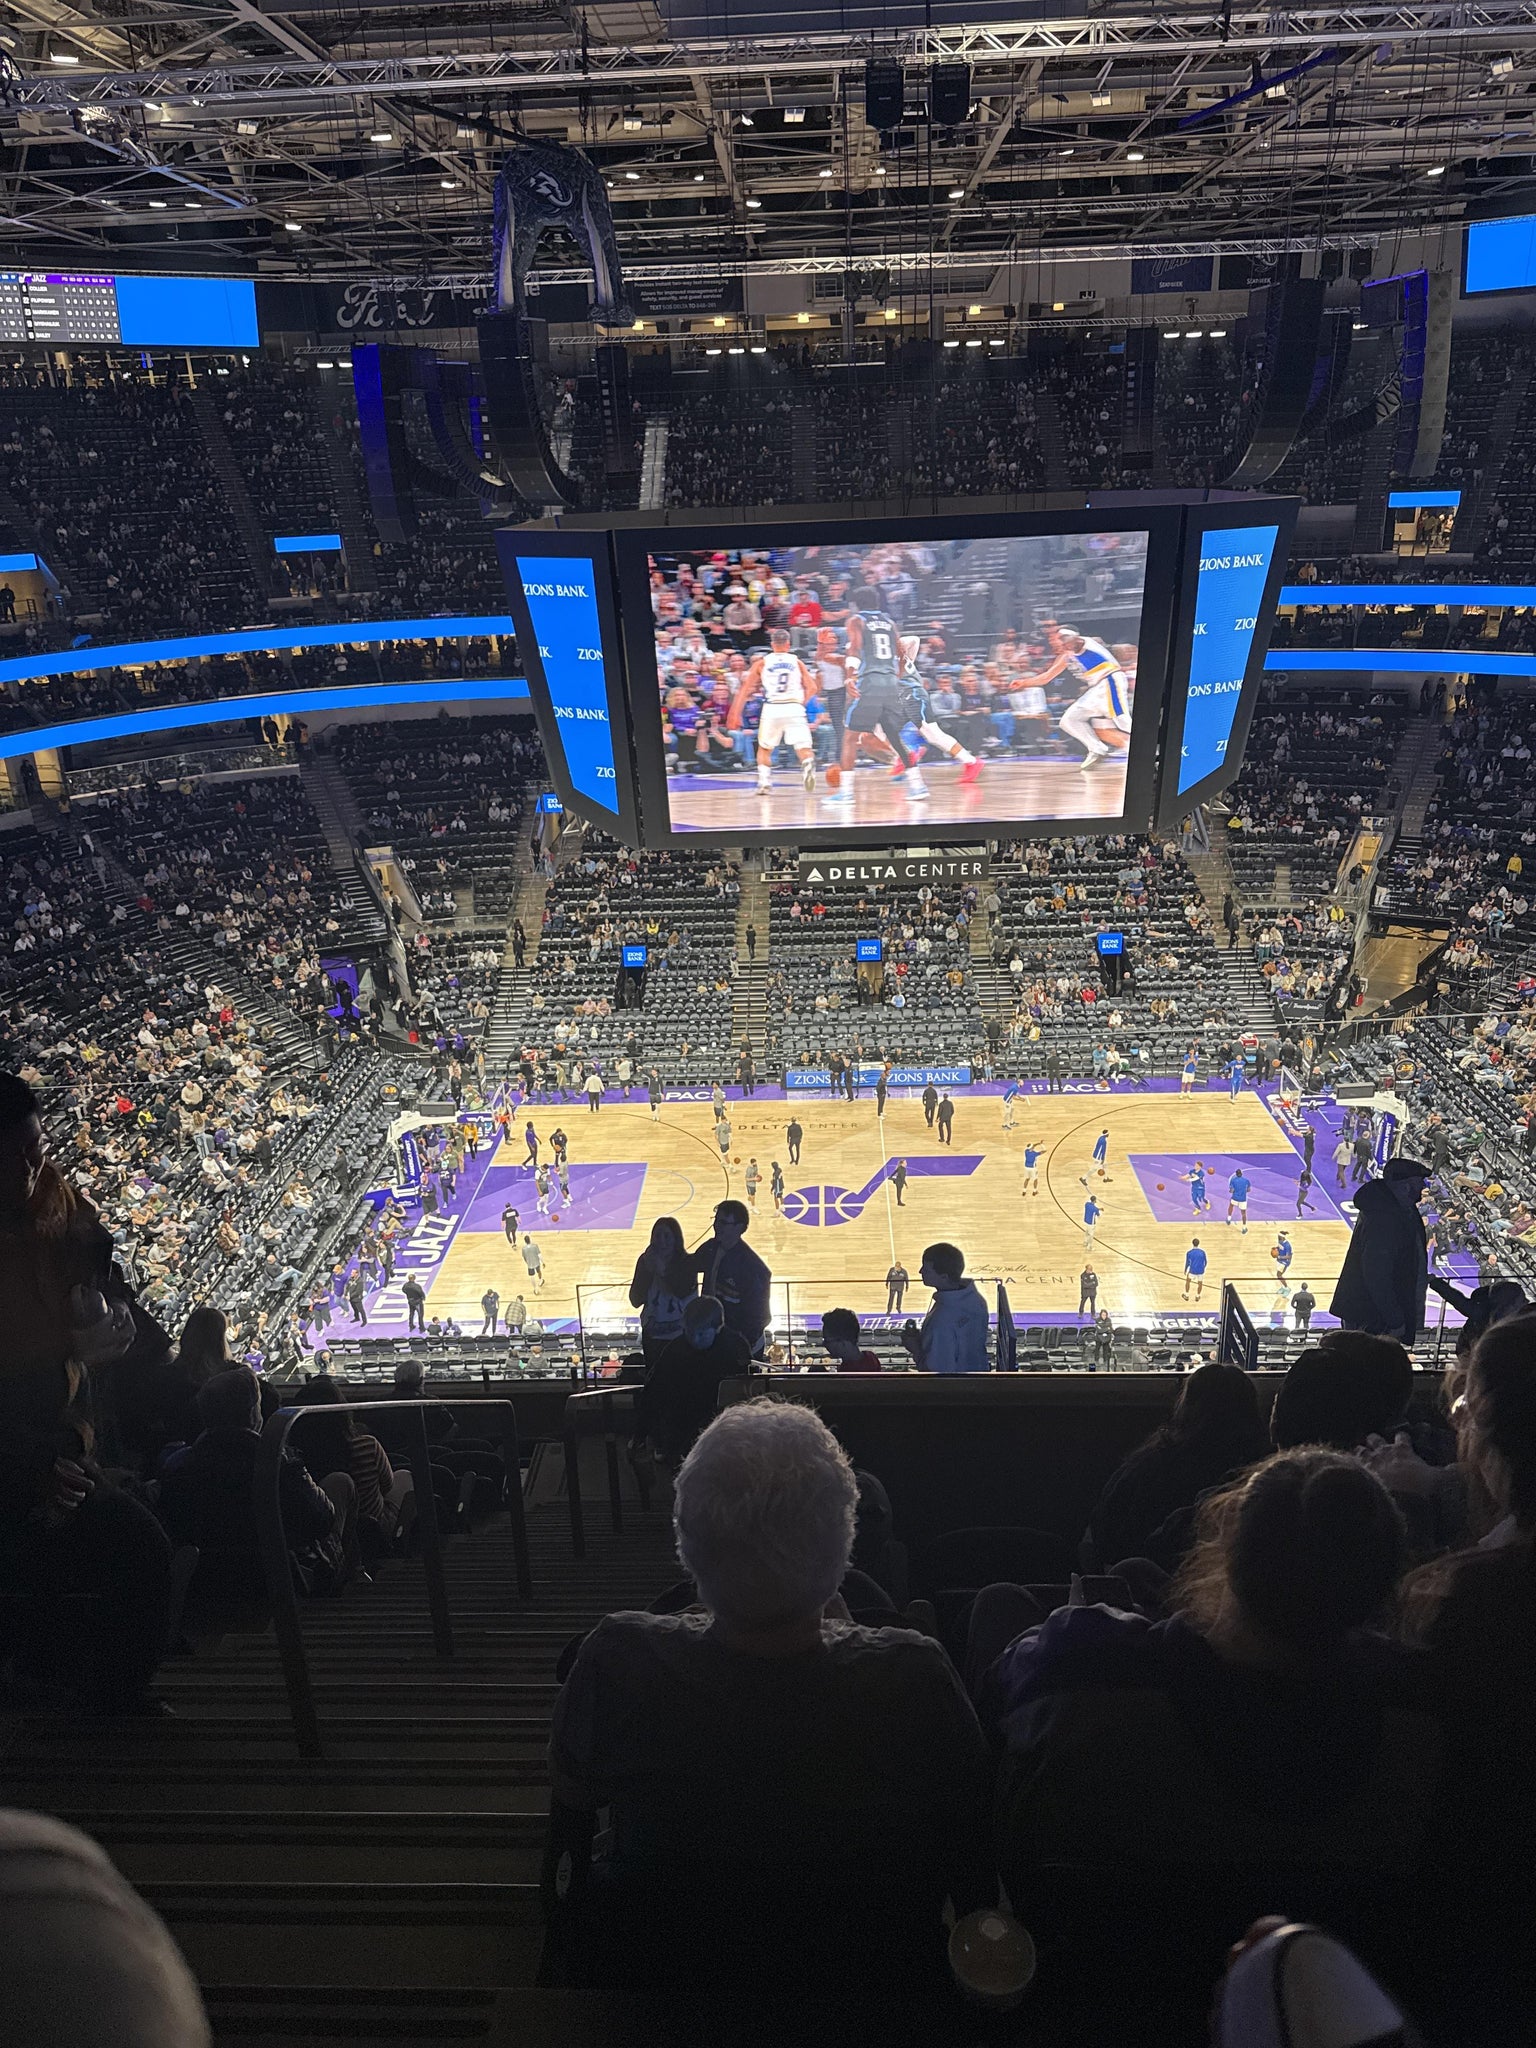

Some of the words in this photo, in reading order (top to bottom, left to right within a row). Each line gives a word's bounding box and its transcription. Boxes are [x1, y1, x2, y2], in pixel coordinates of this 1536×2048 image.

[32, 274, 46, 282] JAZZ
[337, 282, 435, 328] Fod
[1198, 555, 1230, 571] ZIONS
[1234, 553, 1264, 568] BANK
[524, 583, 554, 596] ZIONS
[557, 585, 588, 597] BANK
[875, 633, 892, 660] 8
[1214, 680, 1243, 694] BANK
[576, 708, 608, 721] BANK
[830, 865, 897, 880] DELTA
[905, 862, 982, 878] CENTER
[794, 1074, 830, 1084] ZIONS
[886, 1072, 922, 1082] ZIONS
[926, 1072, 962, 1082] BANK
[402, 1214, 460, 1264] JAZZ
